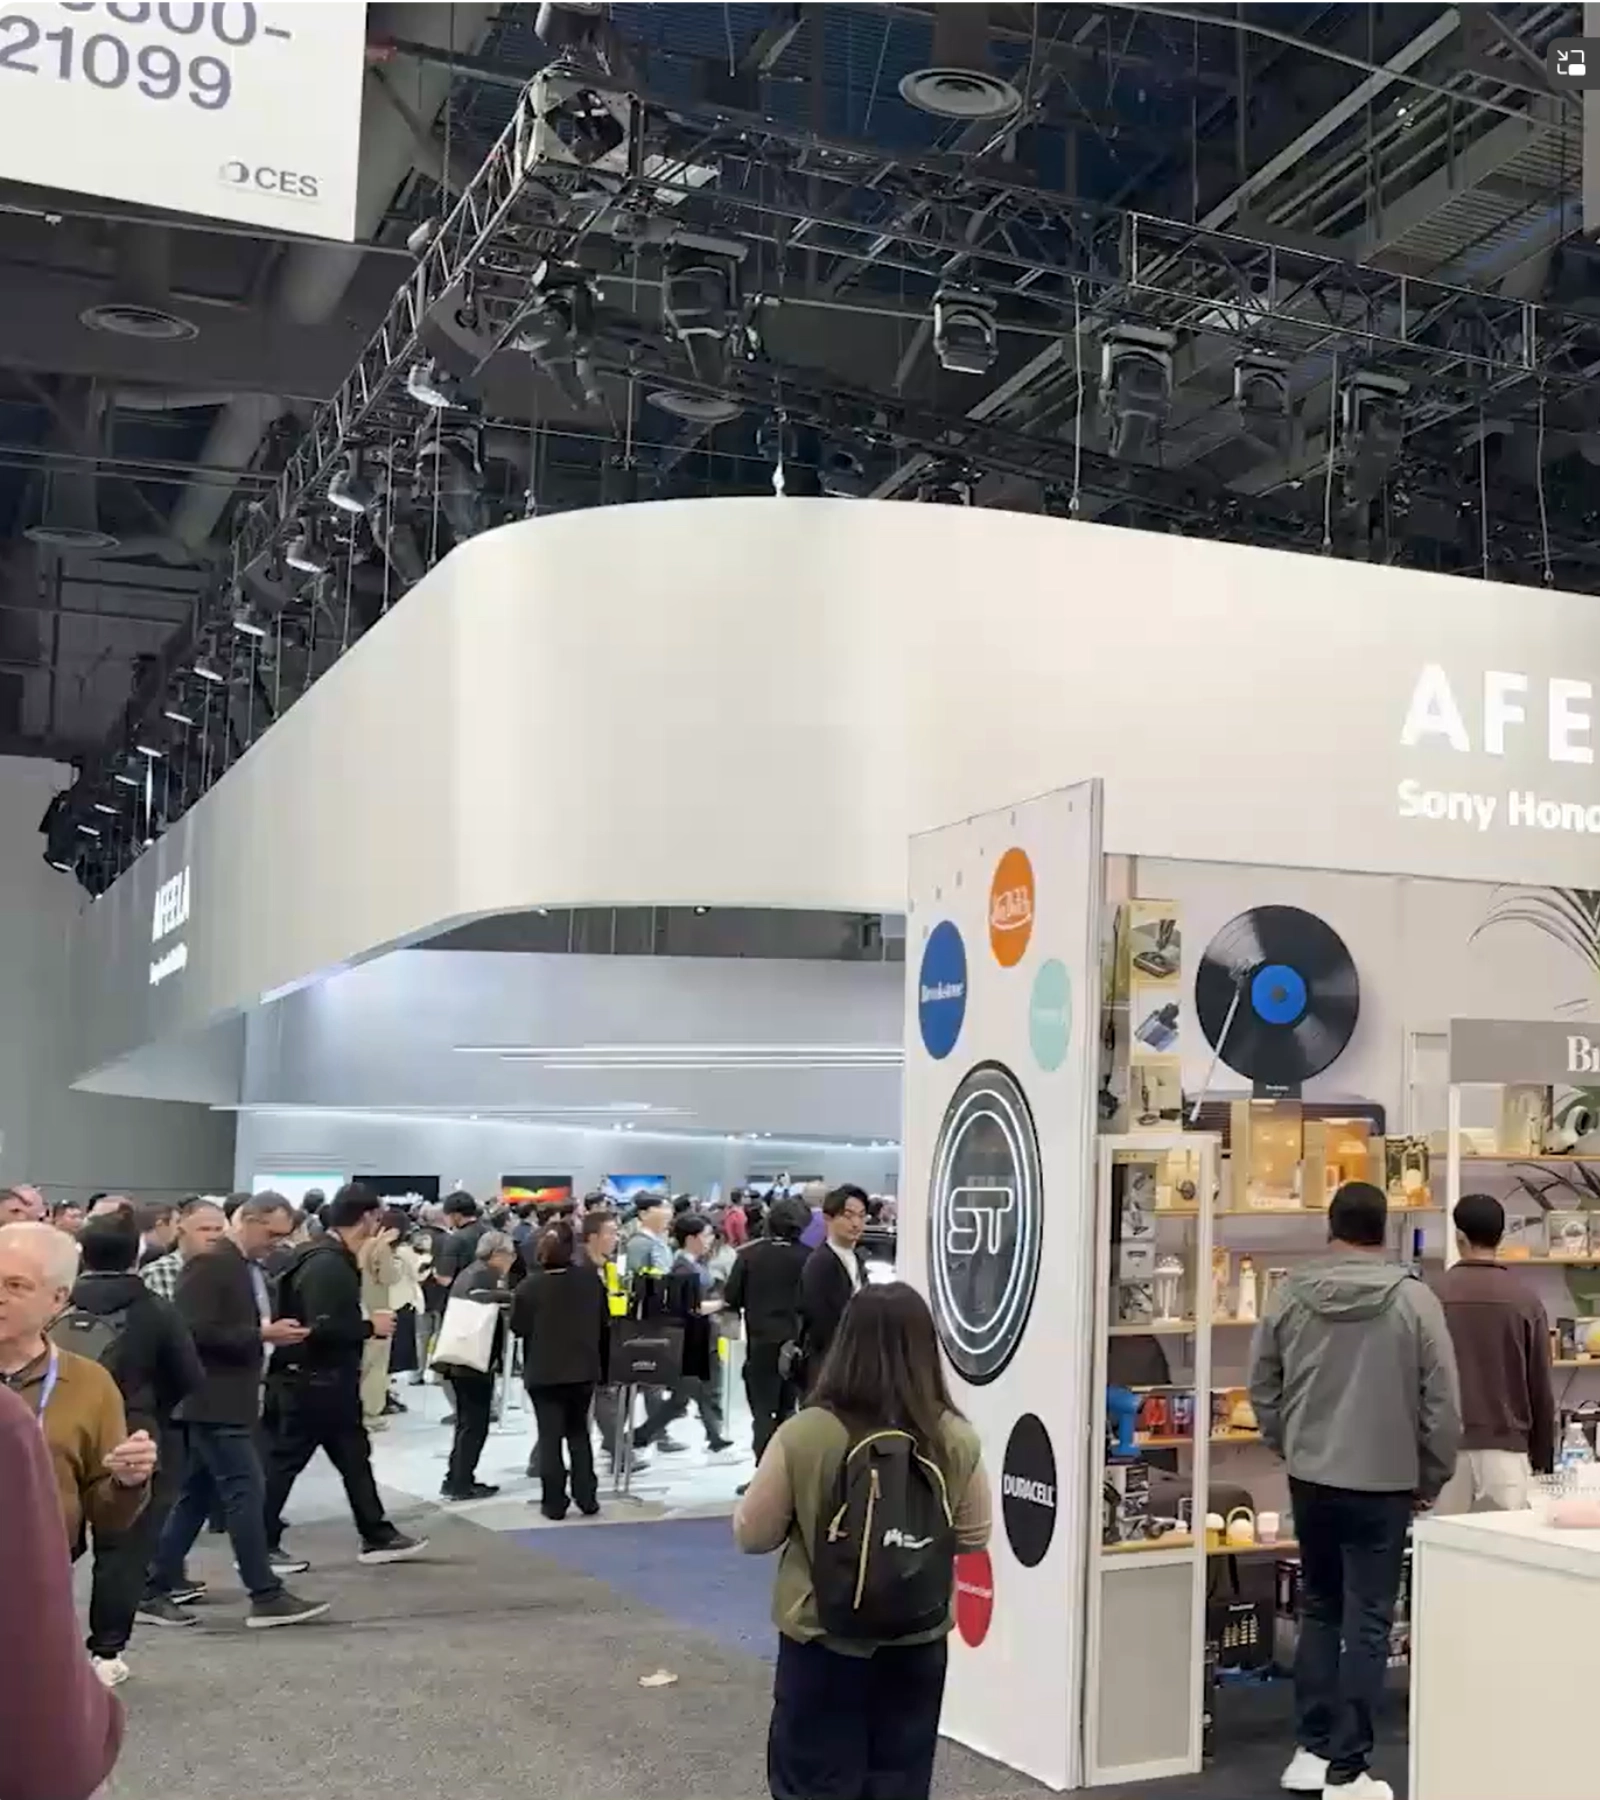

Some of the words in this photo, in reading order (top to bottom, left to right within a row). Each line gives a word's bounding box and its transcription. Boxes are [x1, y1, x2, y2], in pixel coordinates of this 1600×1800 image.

[0, 15, 232, 110] 21099
[254, 167, 319, 198] CES
[1398, 779, 1496, 831] Sony
[1003, 1473, 1054, 1507] DURACELL
